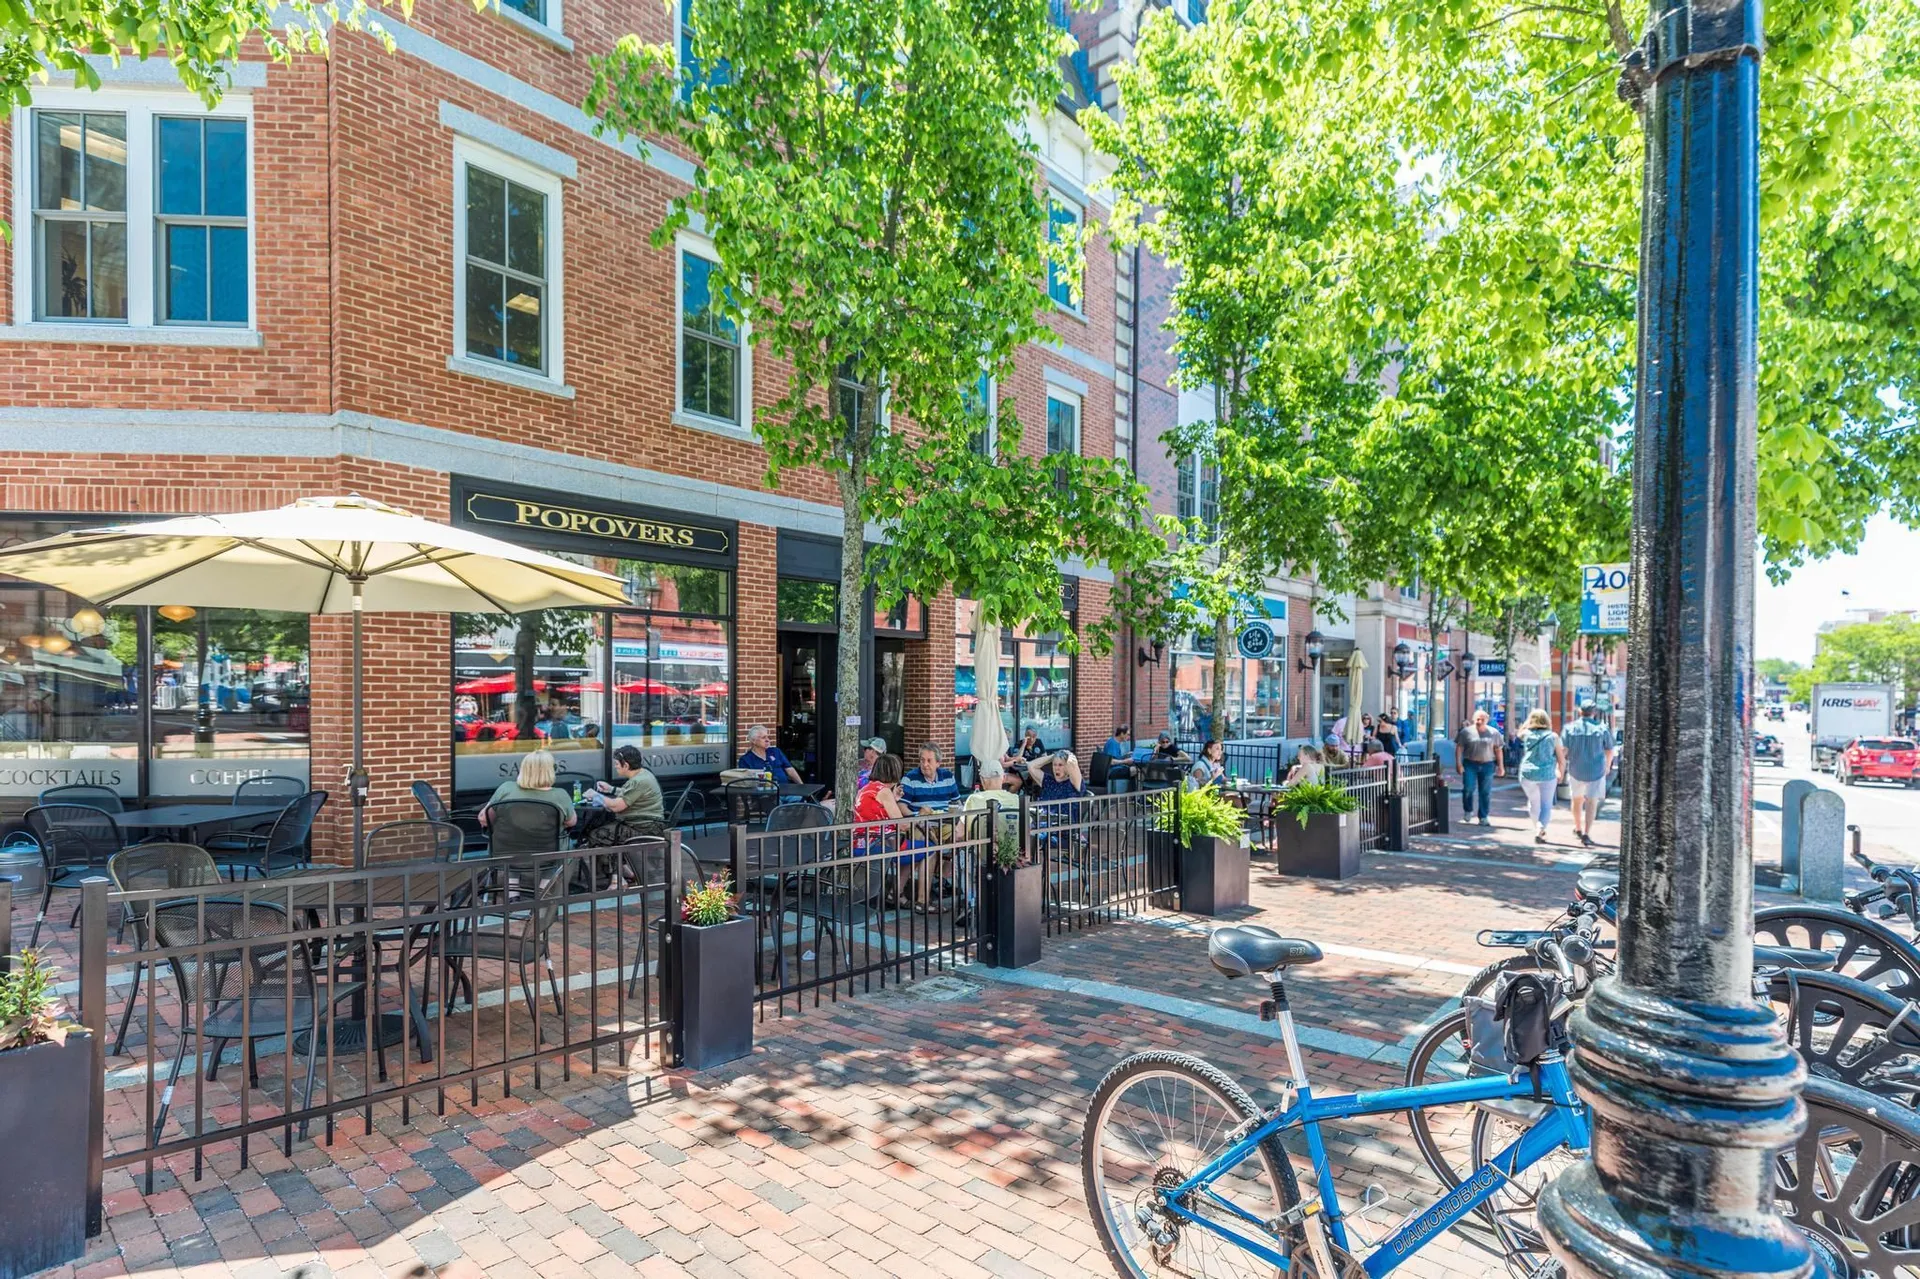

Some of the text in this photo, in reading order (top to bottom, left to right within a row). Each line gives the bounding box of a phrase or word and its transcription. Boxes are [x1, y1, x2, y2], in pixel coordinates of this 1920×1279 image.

[515, 502, 694, 546] POPOVERS
[1821, 697, 1881, 708] KRISWAY
[0, 769, 121, 786] COCKTAILS
[190, 769, 274, 785] COFFEE
